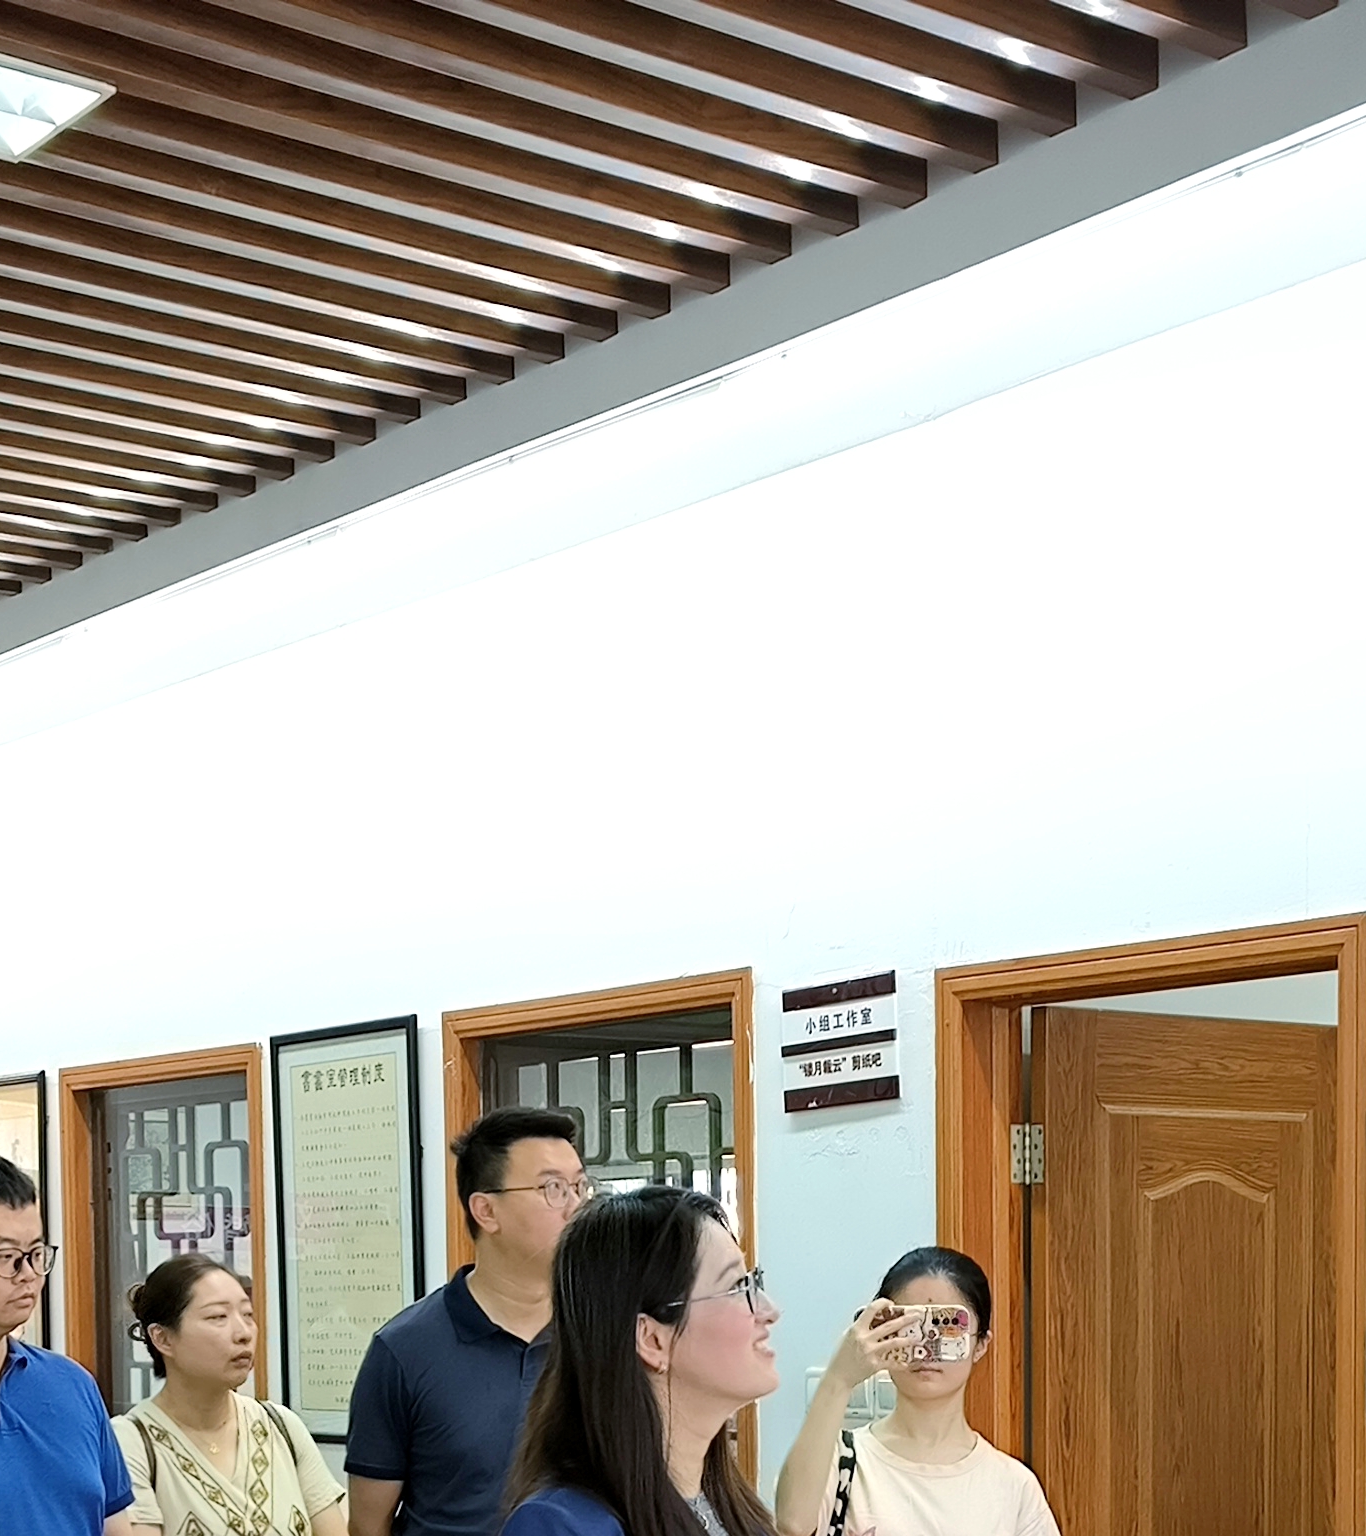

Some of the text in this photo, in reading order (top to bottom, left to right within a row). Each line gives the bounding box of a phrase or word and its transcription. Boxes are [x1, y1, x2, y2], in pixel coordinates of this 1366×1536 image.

[805, 1007, 872, 1035] 小组工作室
